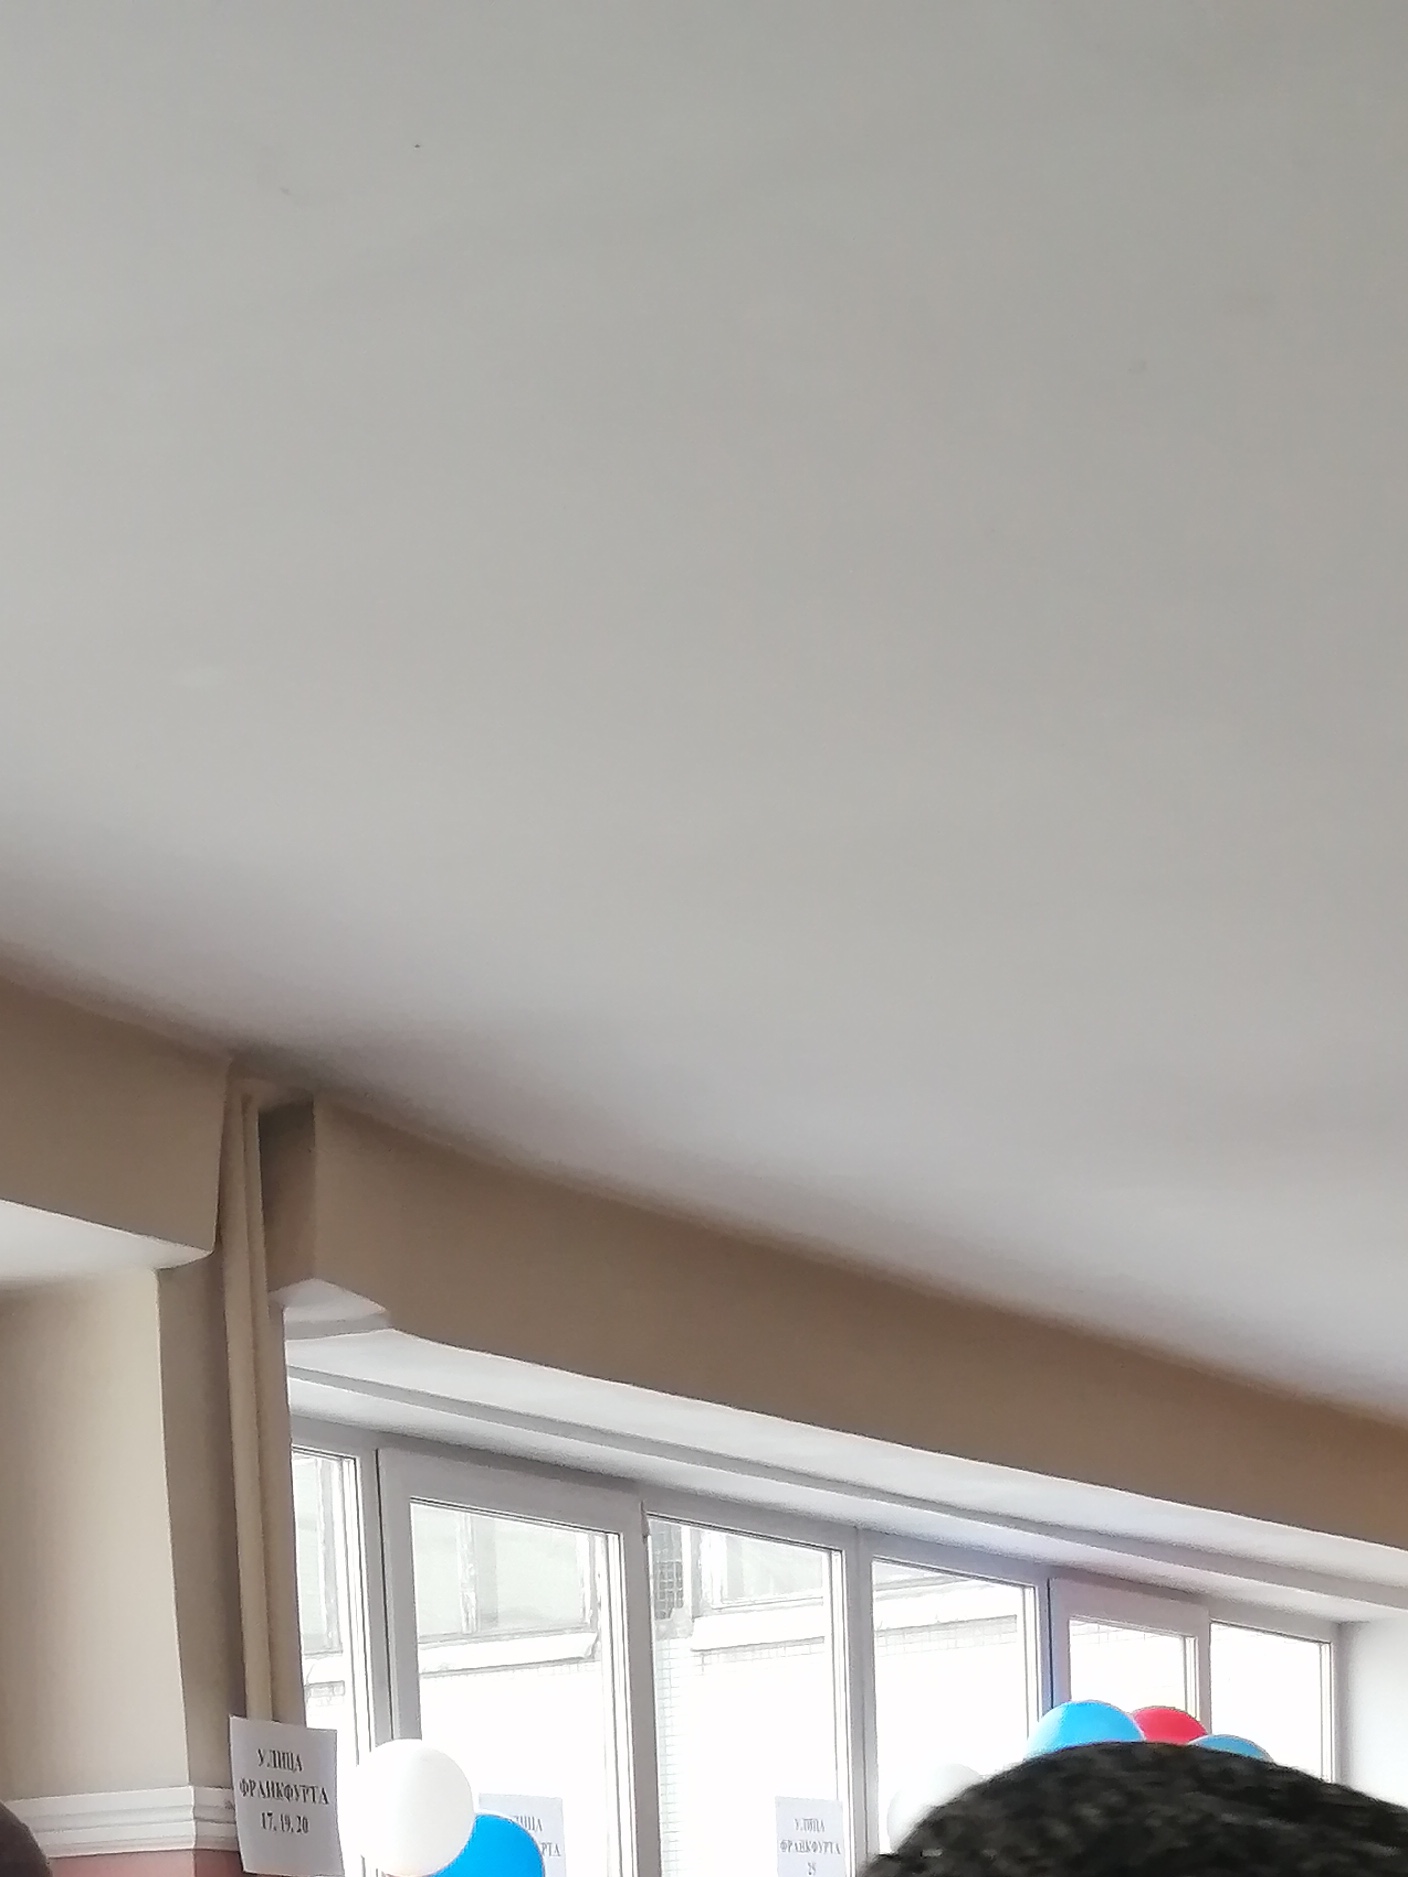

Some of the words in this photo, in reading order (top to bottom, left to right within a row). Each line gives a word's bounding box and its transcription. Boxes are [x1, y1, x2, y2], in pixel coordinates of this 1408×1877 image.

[257, 1748, 303, 1773] УЛИЦА
[239, 1778, 330, 1805] ФРАНКФУРТА
[794, 1818, 825, 1832] УЛИЦА
[779, 1839, 841, 1855] ФРАНКФУРТА
